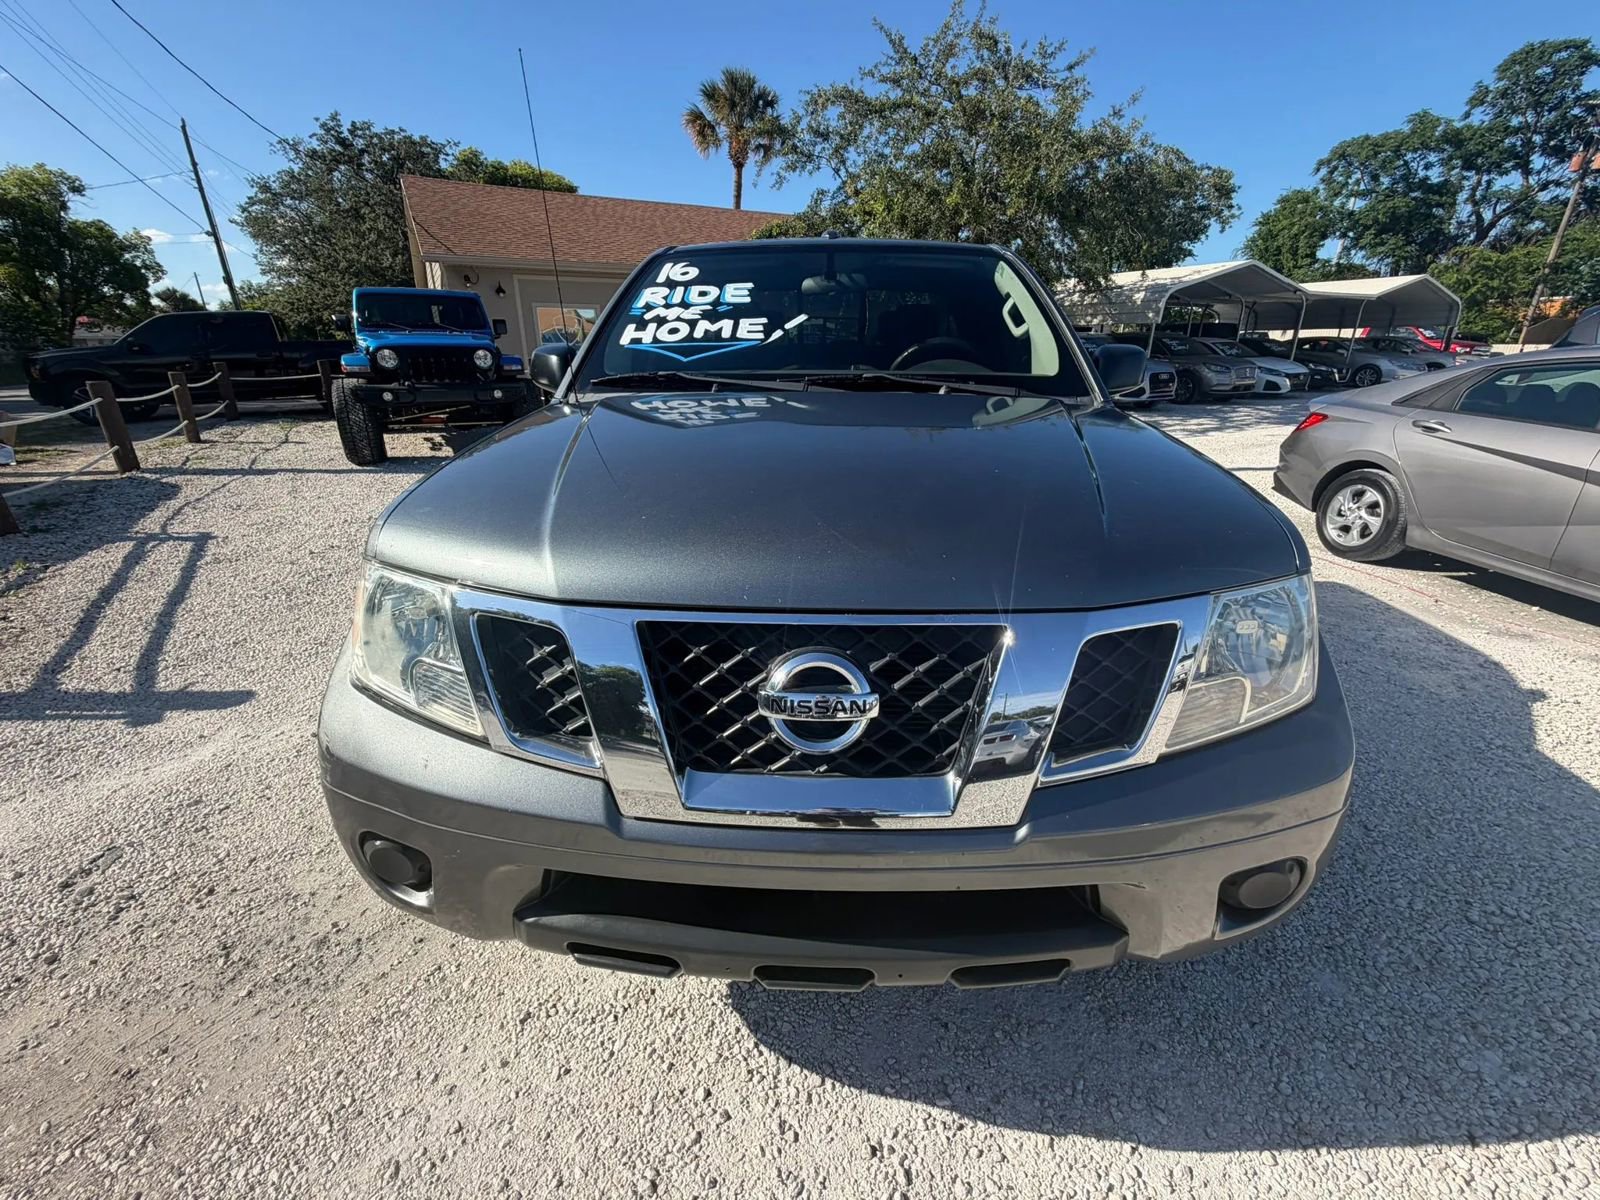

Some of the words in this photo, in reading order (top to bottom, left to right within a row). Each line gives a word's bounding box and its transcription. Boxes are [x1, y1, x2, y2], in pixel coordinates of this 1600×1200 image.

[656, 262, 700, 283] 16
[632, 282, 755, 309] RIDE
[643, 304, 713, 321] ME
[770, 699, 867, 715] NISSAN
